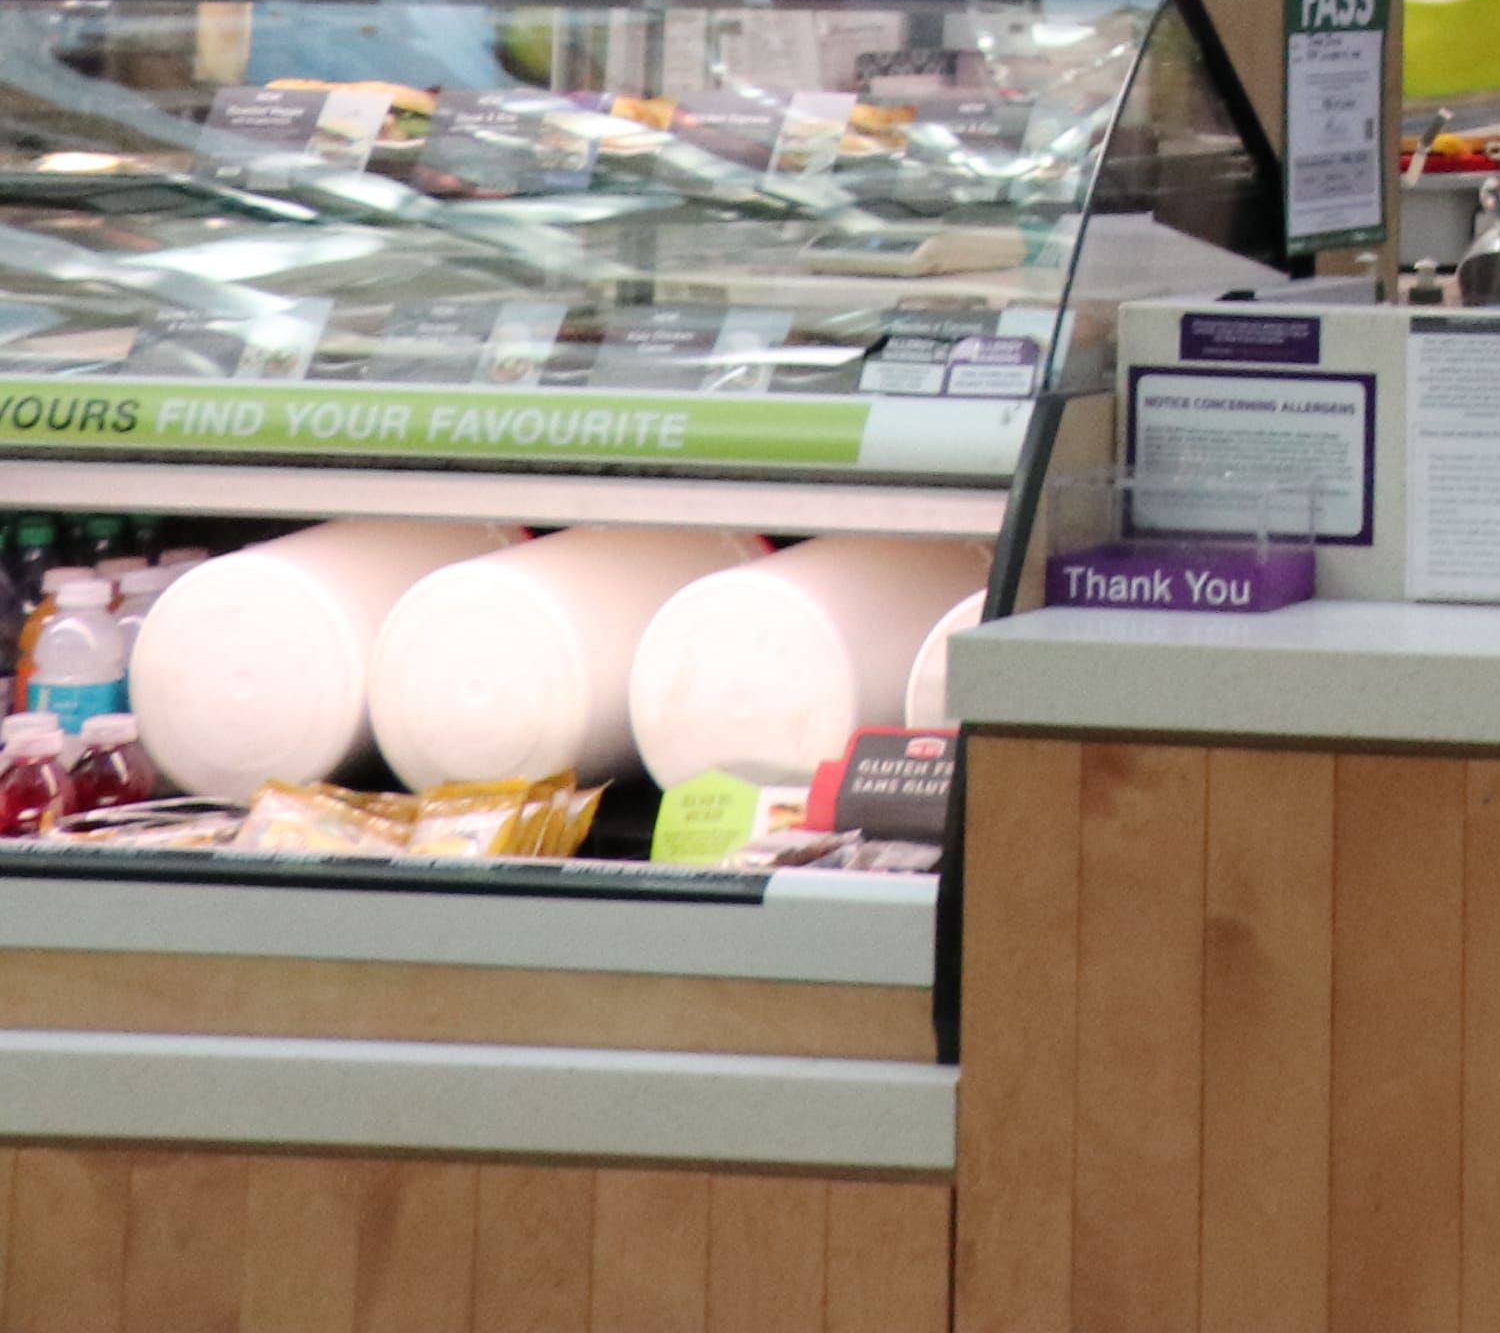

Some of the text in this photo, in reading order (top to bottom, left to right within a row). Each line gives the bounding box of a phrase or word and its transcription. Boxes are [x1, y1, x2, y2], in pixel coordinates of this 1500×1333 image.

[155, 398, 265, 435] FIND
[286, 402, 413, 441] YOUR
[427, 406, 690, 450] FAVOURITE
[1145, 396, 1356, 415] NOTICE CONCERNING ALLERGENS
[1064, 566, 1250, 605] Thank You
